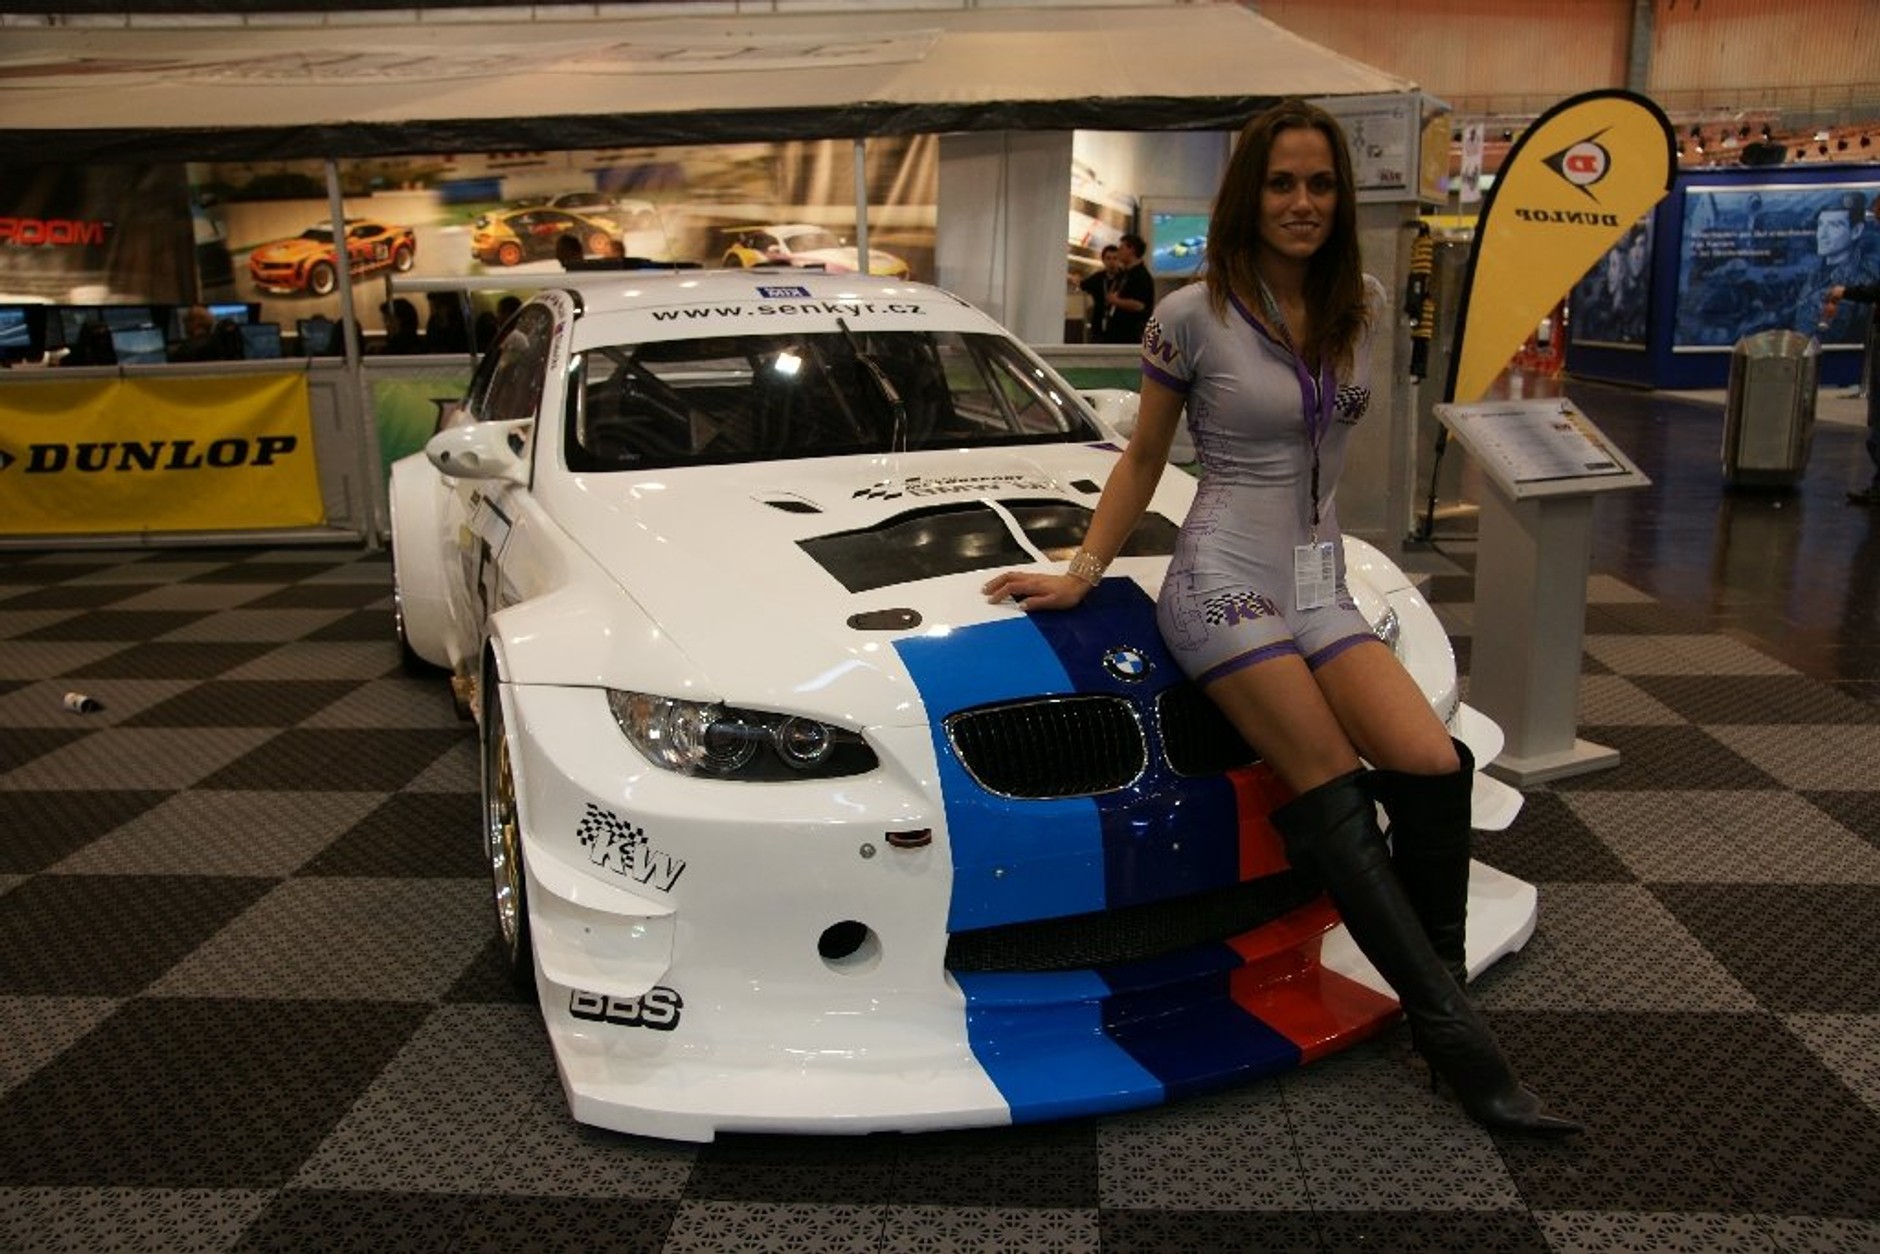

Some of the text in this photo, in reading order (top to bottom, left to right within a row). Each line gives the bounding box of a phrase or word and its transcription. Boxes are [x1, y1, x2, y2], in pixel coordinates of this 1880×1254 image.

[652, 302, 927, 321] www.senkyr.cz
[25, 436, 297, 474] DUNLOP
[590, 829, 686, 892] KW
